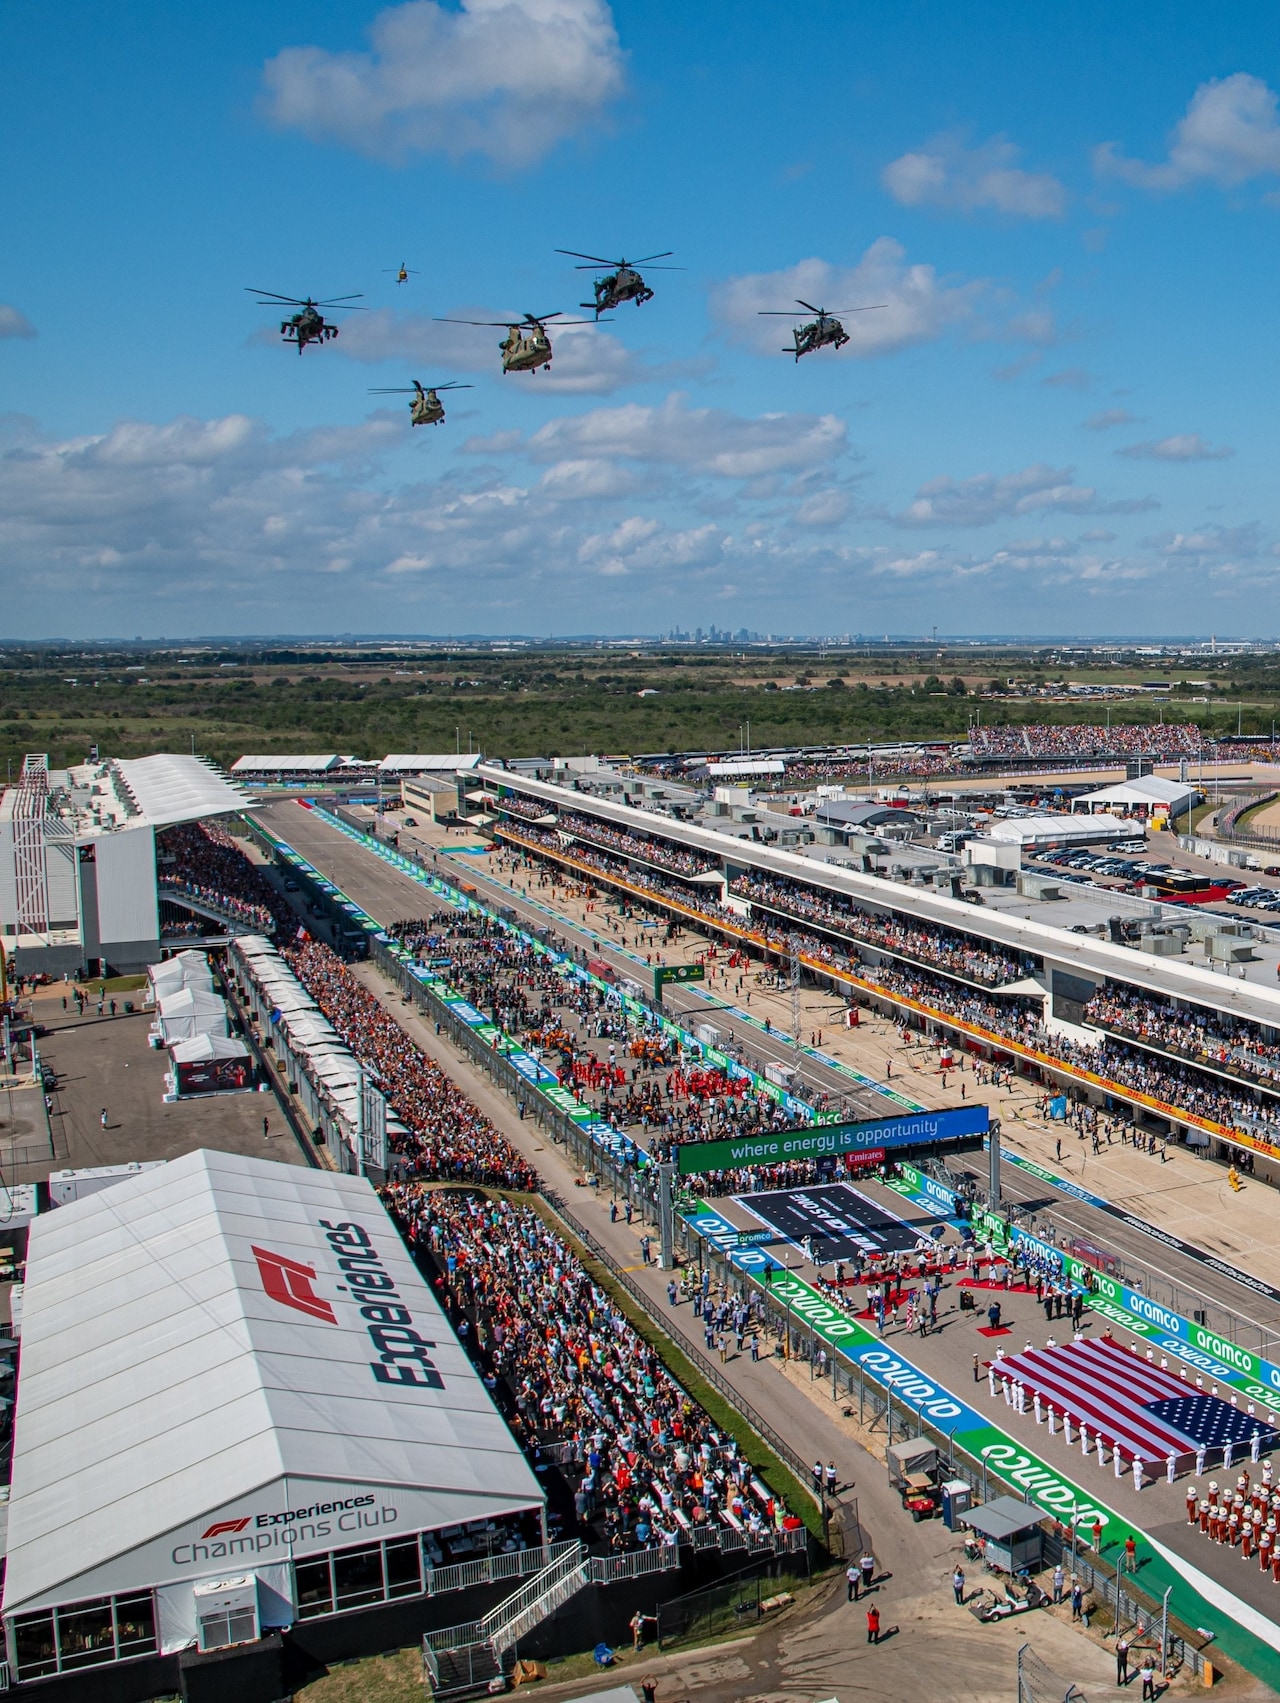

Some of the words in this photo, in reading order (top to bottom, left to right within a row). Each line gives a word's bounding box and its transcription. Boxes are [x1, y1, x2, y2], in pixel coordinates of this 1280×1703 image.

[1048, 1057, 1063, 1067] DHL
[1073, 1067, 1089, 1079] DHL
[758, 1079, 780, 1101] aramco
[1100, 1079, 1116, 1090] DHL
[1127, 1090, 1144, 1101] DHL
[1156, 1101, 1174, 1114] DHL
[1186, 1113, 1205, 1127] DHL
[731, 1139, 780, 1160] where
[783, 1133, 835, 1155] energy
[839, 1130, 850, 1144] is
[857, 1116, 939, 1144] opportunity
[1219, 1126, 1238, 1140] DHL
[1253, 1140, 1273, 1154] DHL
[849, 1151, 883, 1163] Emirates
[926, 1181, 954, 1207] aramc
[738, 1230, 772, 1244] aramco
[250, 1244, 339, 1325] F1
[1071, 1263, 1115, 1298] armco
[318, 1219, 446, 1390] Experiences
[772, 1281, 854, 1337] aramco
[1130, 1295, 1180, 1333] aramco
[1162, 1339, 1230, 1377] aramco
[1197, 1330, 1252, 1371] aramco
[859, 1351, 962, 1418] aramco
[981, 1444, 1109, 1528] aramco
[201, 1517, 253, 1539] F1
[256, 1494, 375, 1528] Experiences
[172, 1520, 332, 1565] Champions
[338, 1505, 399, 1533] Club
